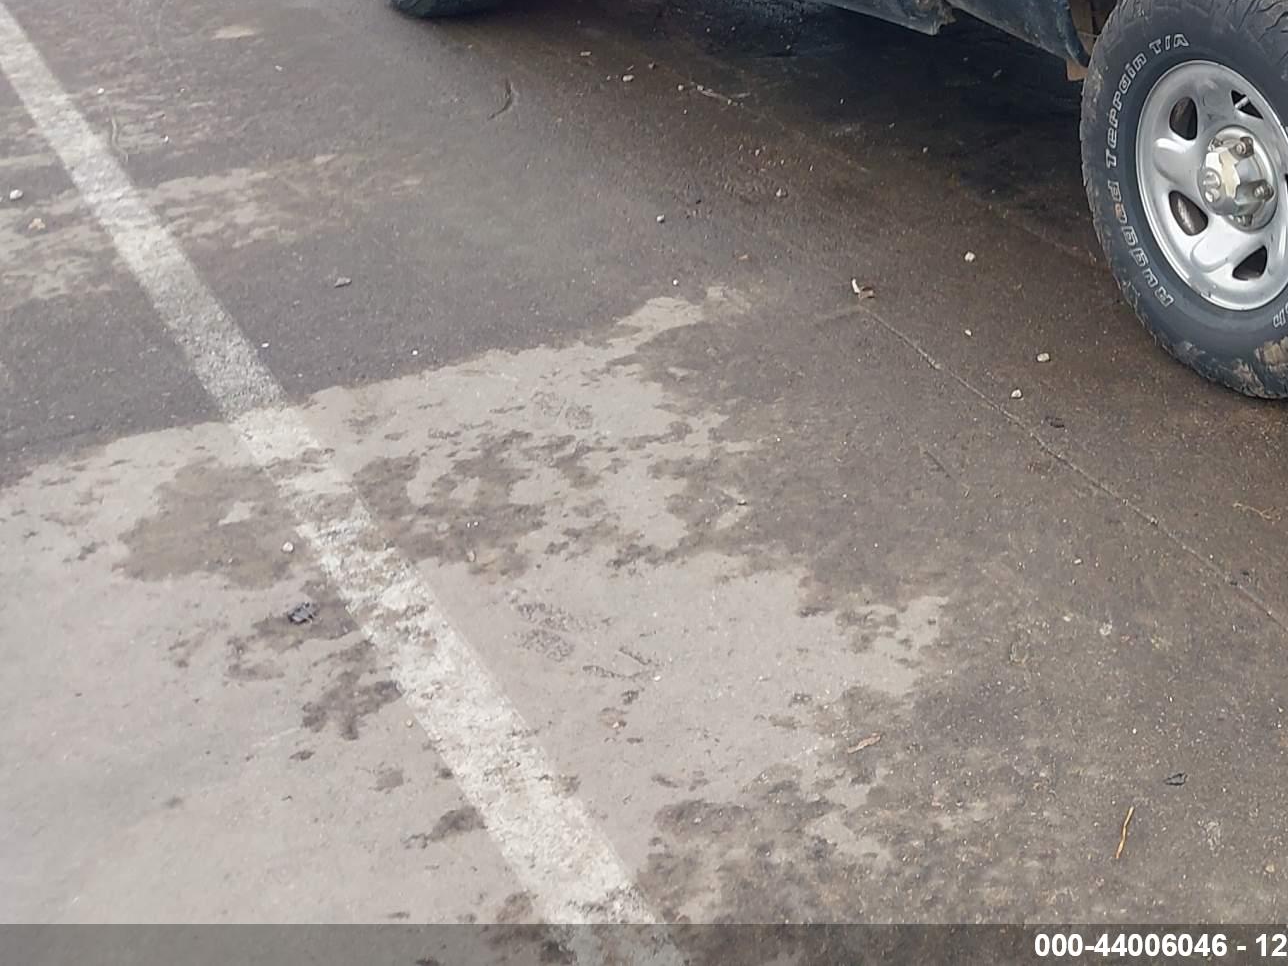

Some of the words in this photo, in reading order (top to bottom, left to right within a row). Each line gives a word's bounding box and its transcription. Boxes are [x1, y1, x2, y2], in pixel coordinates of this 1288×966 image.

[1149, 32, 1190, 56] T/A
[1105, 52, 1148, 168] Terrain
[1107, 180, 1174, 307] Rugged
